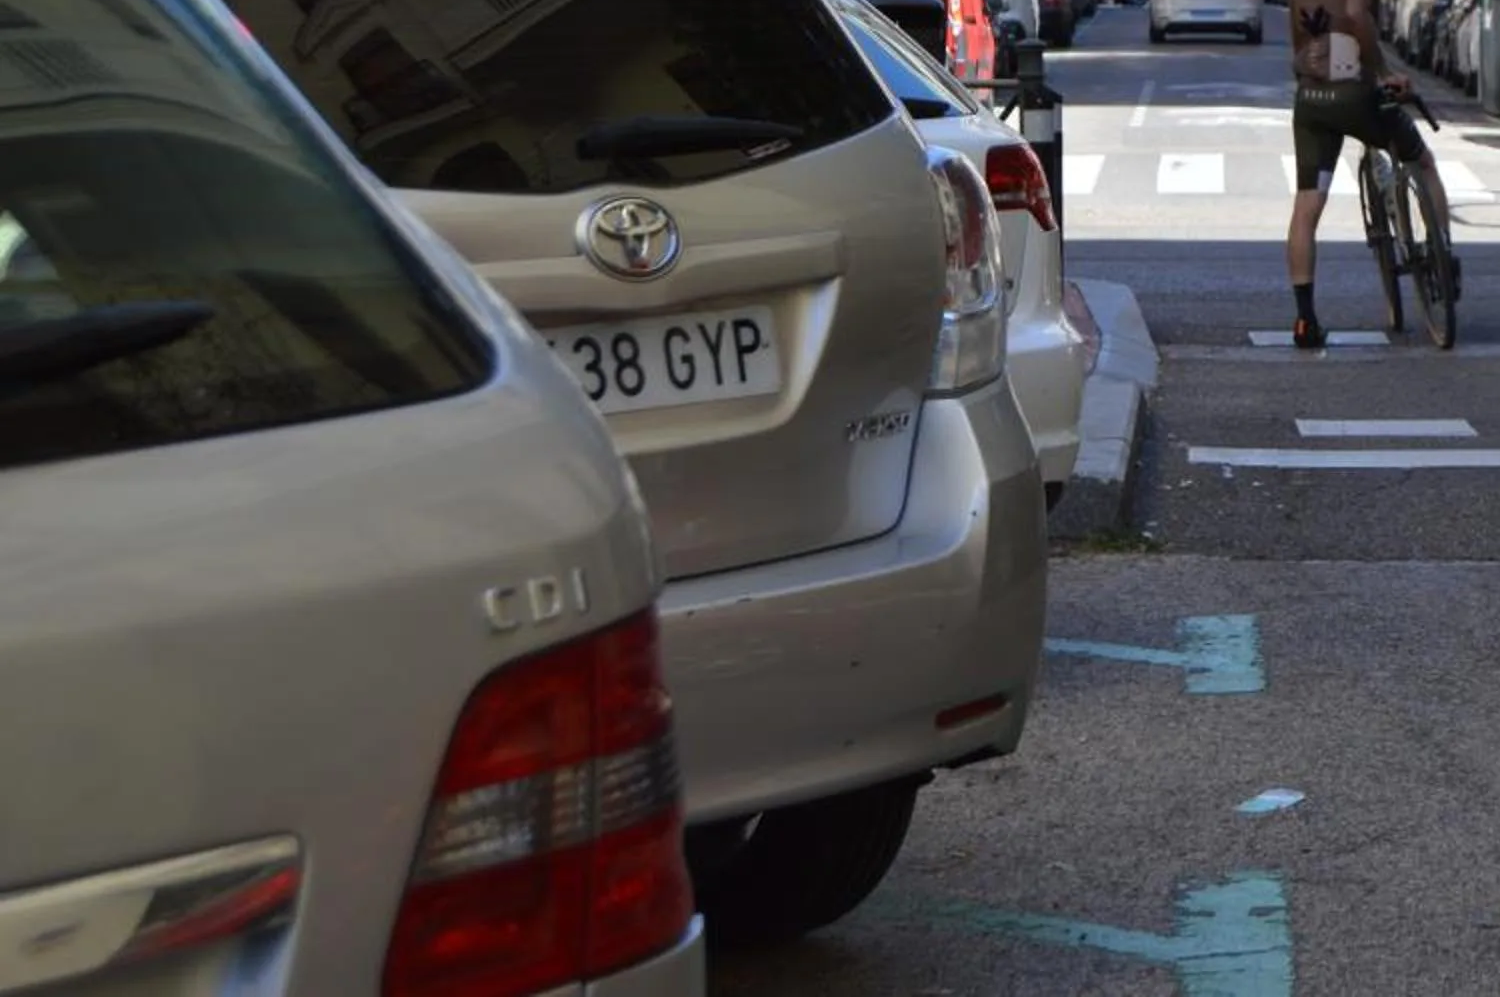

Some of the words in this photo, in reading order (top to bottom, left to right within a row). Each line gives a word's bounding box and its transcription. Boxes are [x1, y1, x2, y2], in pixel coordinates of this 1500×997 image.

[549, 332, 645, 401] 38
[663, 318, 761, 390] GYP
[483, 568, 590, 631] CDI
